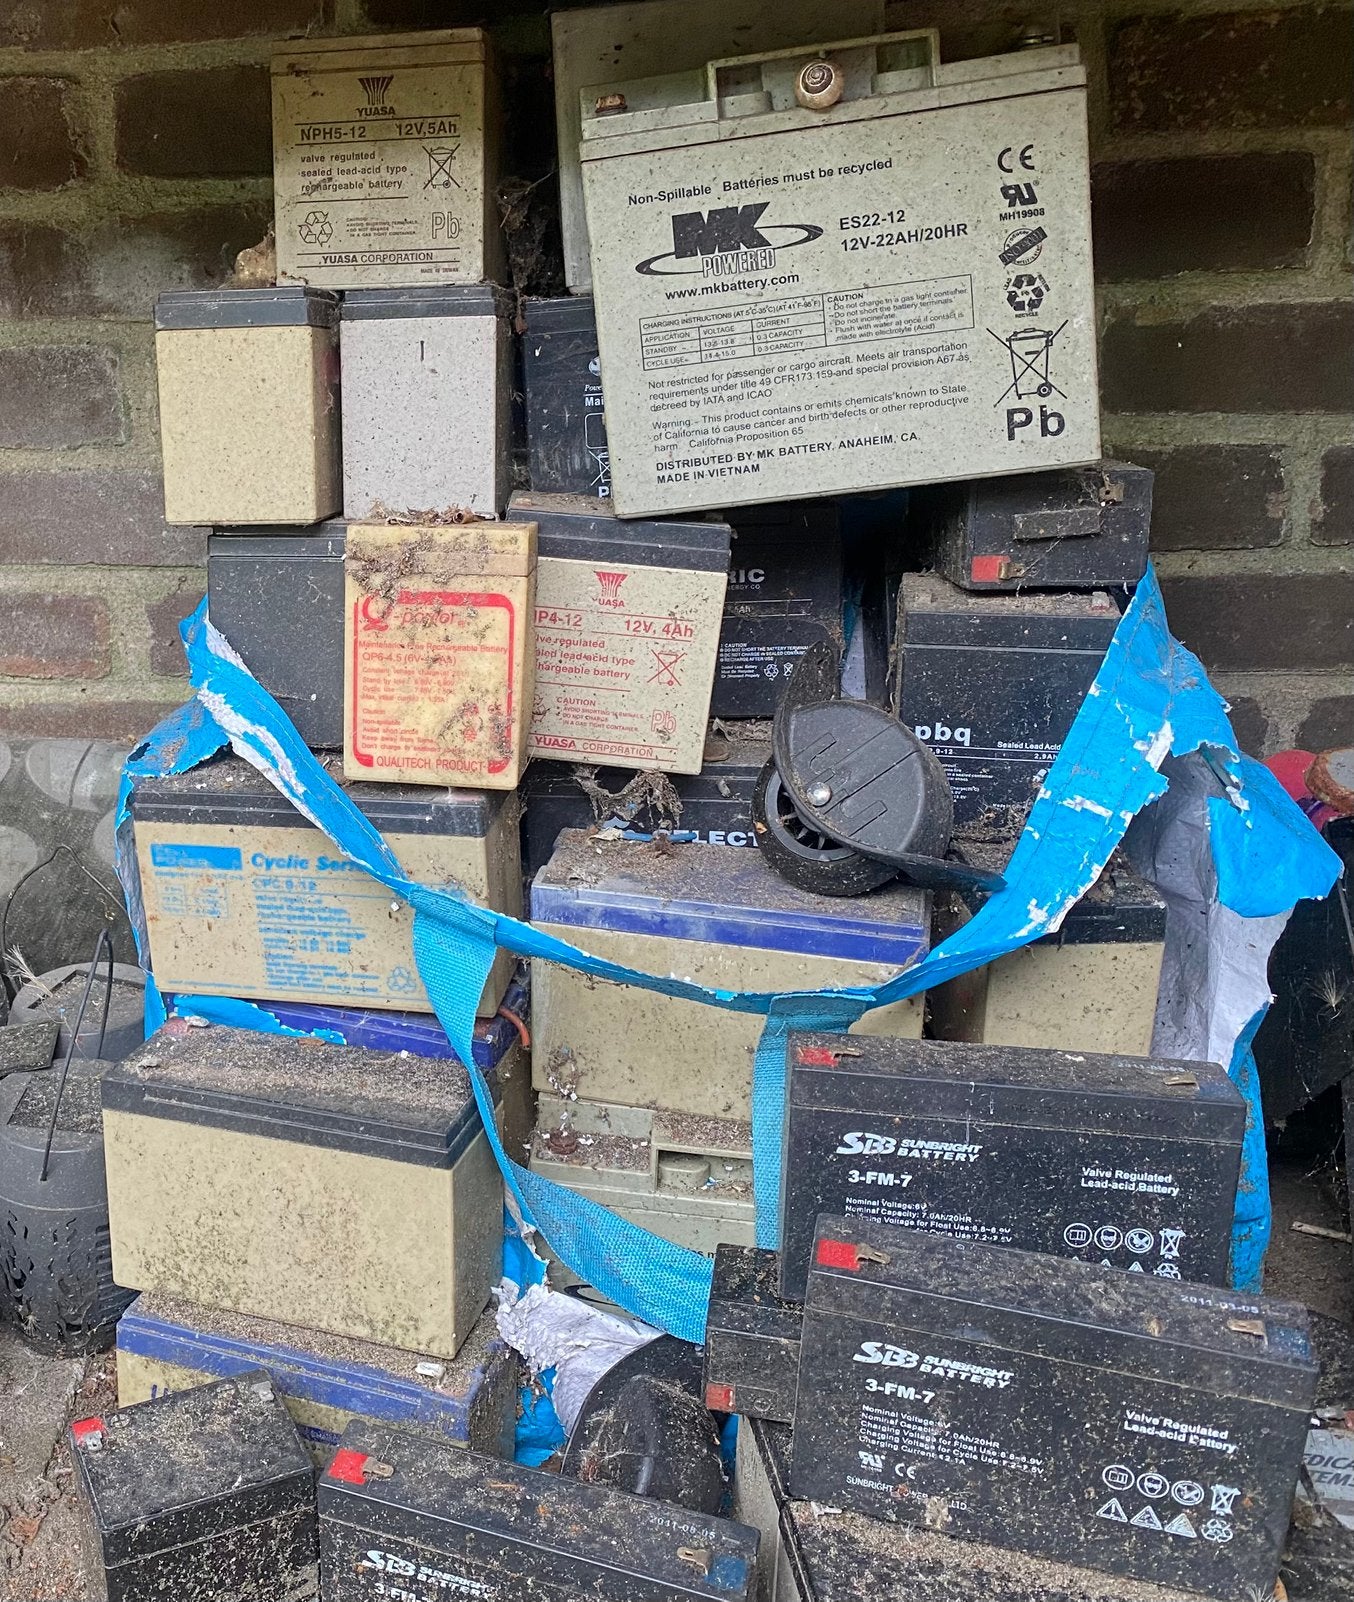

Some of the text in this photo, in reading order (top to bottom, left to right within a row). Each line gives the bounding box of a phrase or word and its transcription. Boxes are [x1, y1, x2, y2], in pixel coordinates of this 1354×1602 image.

[356, 107, 395, 117] YUASA
[301, 121, 457, 141] NPH5-12 12V,5Ah
[301, 152, 376, 162] valve regulated
[300, 166, 407, 177] sealed lead-acid type
[301, 180, 402, 192] rechargeable battery
[628, 158, 892, 205] Non-Spillable Batteries must be recycled
[839, 210, 905, 230] ES22-12
[999, 208, 1045, 221] MH19908
[432, 212, 460, 239] Pb
[672, 202, 772, 260] MK
[841, 223, 968, 252] 12V-22AH/20HR
[322, 253, 433, 263] YUASA CORPORATION
[703, 249, 775, 278] POWERED
[665, 274, 799, 300] www.mkbattery.com
[828, 293, 863, 303] CAUTION
[643, 312, 732, 330] CHARGING INSTRUCTIONS
[645, 318, 790, 343] APPLICATION VOLTAGE CURRENT
[646, 345, 677, 355] STANDBY
[770, 341, 804, 351] CAPACITY
[667, 375, 708, 386] restricted
[712, 372, 724, 380] for
[727, 366, 774, 382] passenger
[790, 362, 816, 372] cargo
[857, 352, 885, 362] Meets
[902, 342, 967, 358] transportation
[650, 387, 708, 401] requirements
[712, 382, 738, 392] under
[759, 377, 771, 386] 49
[836, 368, 853, 376] and
[856, 364, 889, 376] special
[891, 358, 934, 372] provision
[651, 389, 772, 412] decreed by IATA and ICAO
[652, 419, 691, 431] Warning
[702, 415, 721, 423] This
[725, 409, 759, 422] product
[763, 404, 801, 416] contains
[805, 402, 814, 410] or
[817, 401, 842, 411] emits
[845, 394, 892, 406] chemicals
[895, 389, 926, 401] known
[941, 385, 966, 394] State
[653, 433, 662, 441] of
[665, 428, 708, 440] California
[723, 423, 751, 433] cause
[754, 419, 785, 429] cancer
[789, 415, 805, 424] and
[809, 413, 830, 422] birth
[832, 409, 866, 419] defects
[870, 406, 879, 414] or
[882, 403, 906, 413] other
[909, 396, 968, 411] reproductive
[1007, 404, 1065, 441] Pb
[689, 427, 804, 448] California Proposition 65
[656, 455, 733, 471] DISTRIBUTED
[738, 452, 752, 461] BY
[757, 449, 774, 459] MK
[657, 464, 760, 484] MADE IN VIETNAM
[662, 623, 693, 637] 4Ah
[555, 638, 605, 648] regulated
[362, 653, 402, 661] QP6-4.5
[560, 652, 635, 666] lead-acid type
[594, 668, 630, 680] battery
[557, 697, 595, 706] CAUTION
[651, 709, 676, 734] Pb
[915, 722, 971, 746] pbq
[536, 736, 653, 757] YUASA CORPORATION
[997, 741, 1023, 749] Sealed
[1025, 742, 1043, 750] Lead
[377, 756, 430, 769] QUALITECH
[901, 1138, 983, 1153] SUNBRIGHT
[897, 1148, 980, 1162] BATTERY
[848, 1170, 912, 1187] 3-FM-7
[1082, 1167, 1172, 1183] Valve Regulated
[1081, 1178, 1179, 1196] Lead-acid Battery
[846, 1197, 879, 1206] Nominal
[845, 1205, 879, 1214] Nominal
[881, 1209, 919, 1218] Capacity:
[884, 1217, 914, 1226] Voltage
[930, 1221, 951, 1230] Float
[920, 1364, 1010, 1389] BATTERY
[923, 1355, 1014, 1380] SUNBRIGHT
[865, 1379, 935, 1403] 3-FM-7
[862, 1413, 898, 1425] Nominal
[863, 1405, 898, 1418] Nominal
[1124, 1422, 1186, 1443] Lead-acid
[1125, 1410, 1228, 1439] Valve Regulated
[859, 1436, 898, 1451] Charging
[860, 1428, 978, 1461] Charging Voltage for Cycle
[861, 1420, 978, 1452] Charging Voltage for Float
[847, 1476, 892, 1492] SUNBRIGHT
